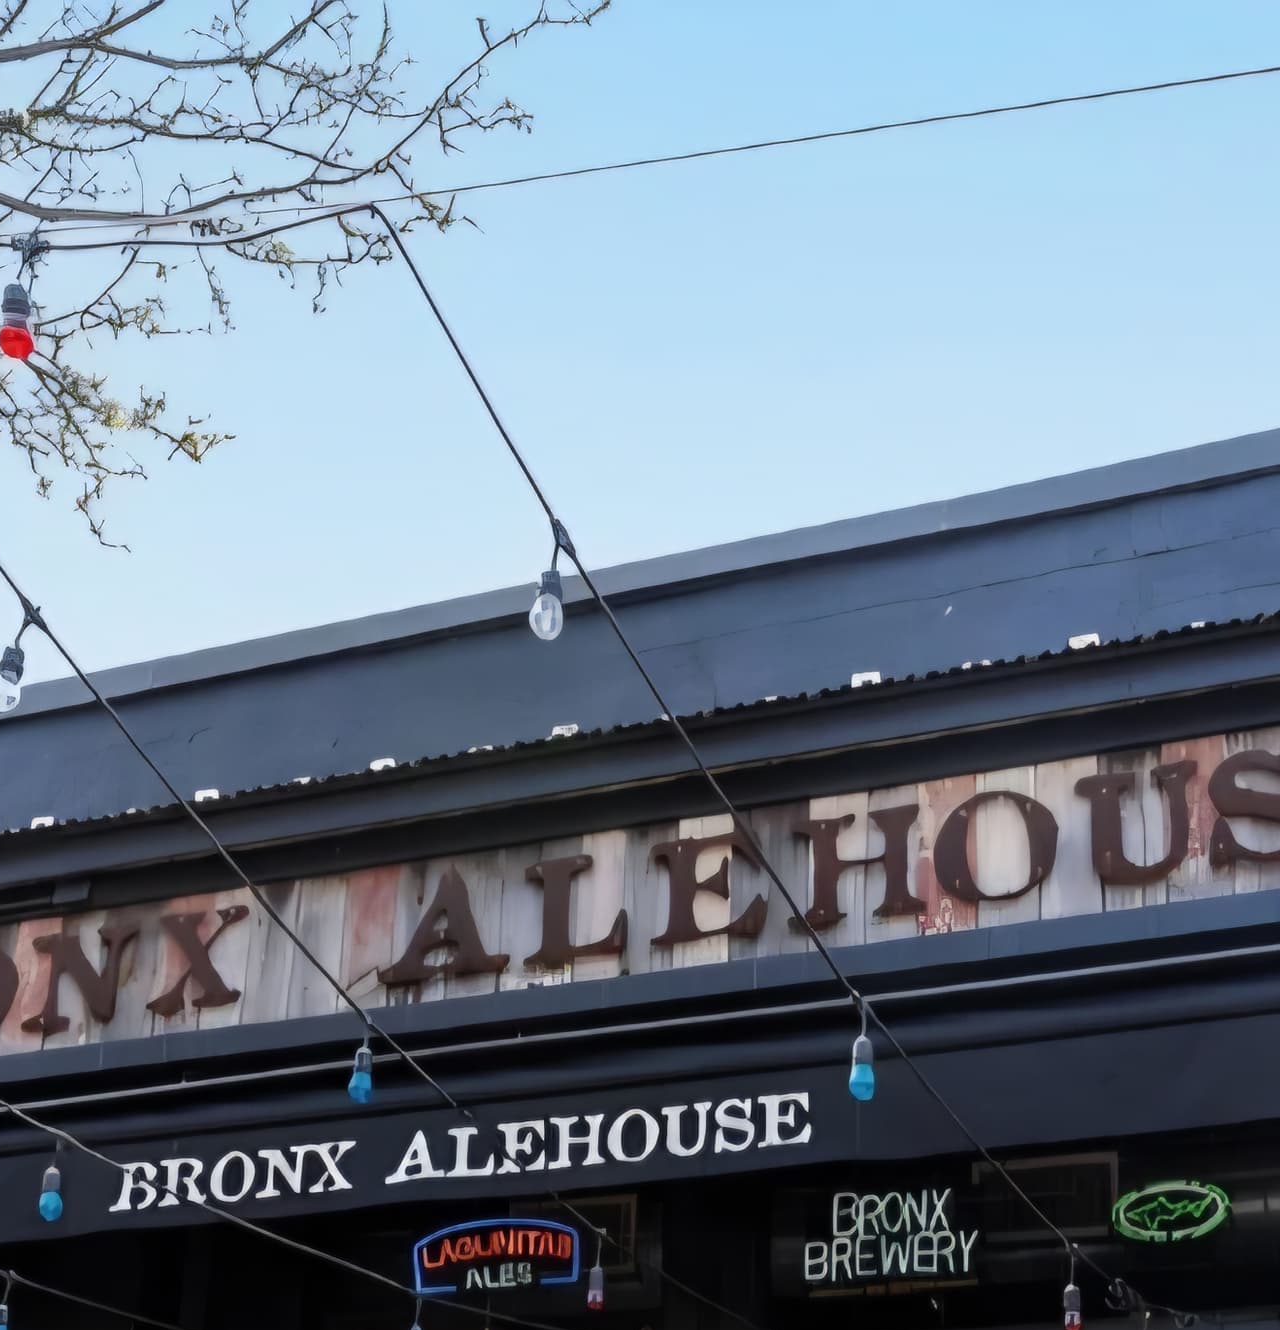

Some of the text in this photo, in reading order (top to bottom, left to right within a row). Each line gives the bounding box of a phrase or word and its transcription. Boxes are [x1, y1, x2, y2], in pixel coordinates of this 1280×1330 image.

[108, 1092, 810, 1212] BRONX ALEHOUSE
[833, 1188, 951, 1237] BRONX
[805, 1229, 978, 1282] BREWERY
